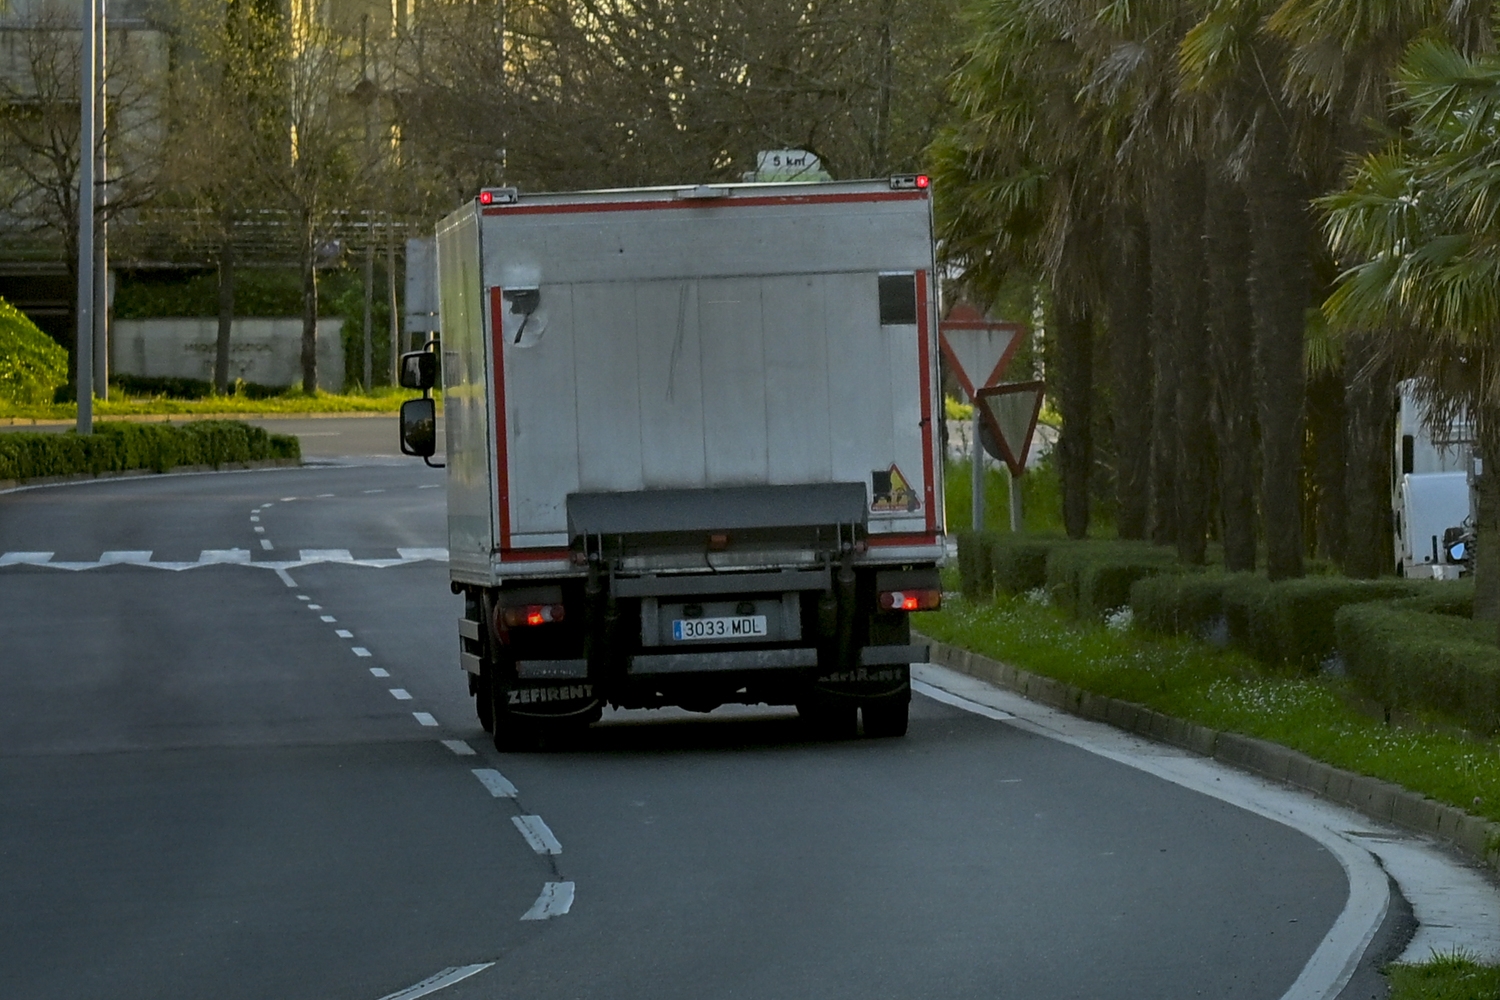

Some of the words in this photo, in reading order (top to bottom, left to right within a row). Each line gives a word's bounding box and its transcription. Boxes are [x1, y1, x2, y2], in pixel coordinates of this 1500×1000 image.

[685, 620, 726, 637] 3033
[732, 618, 762, 635] MDL
[507, 684, 594, 705] ZEFIRENT
